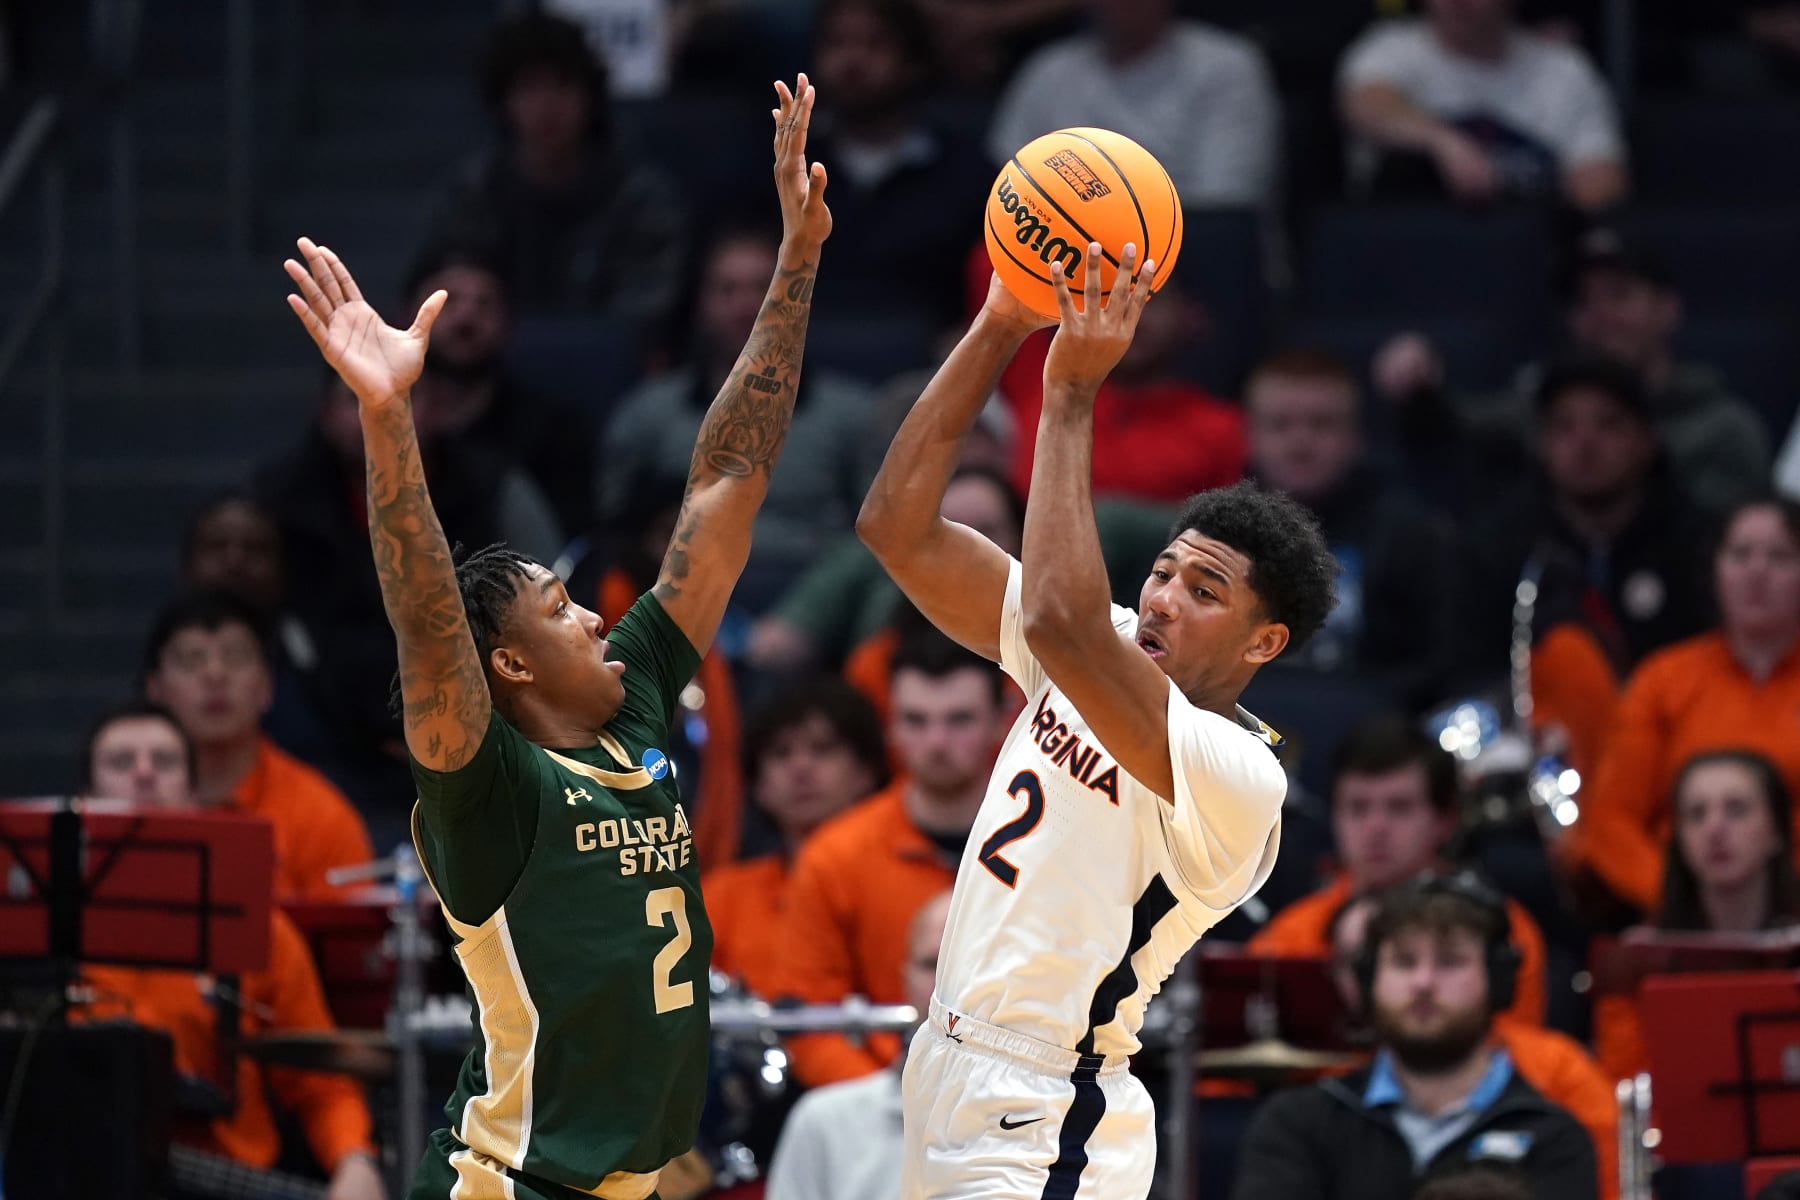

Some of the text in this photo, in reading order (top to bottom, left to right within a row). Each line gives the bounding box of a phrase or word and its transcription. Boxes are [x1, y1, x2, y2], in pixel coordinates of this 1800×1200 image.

[998, 175, 1082, 279] Wilson
[1036, 208, 1052, 223] EVO
[648, 756, 668, 777] NCAA
[1030, 688, 1120, 807] RGINIA
[575, 803, 692, 852] COLRA
[977, 768, 1046, 890] 2
[645, 886, 694, 1015] 2
